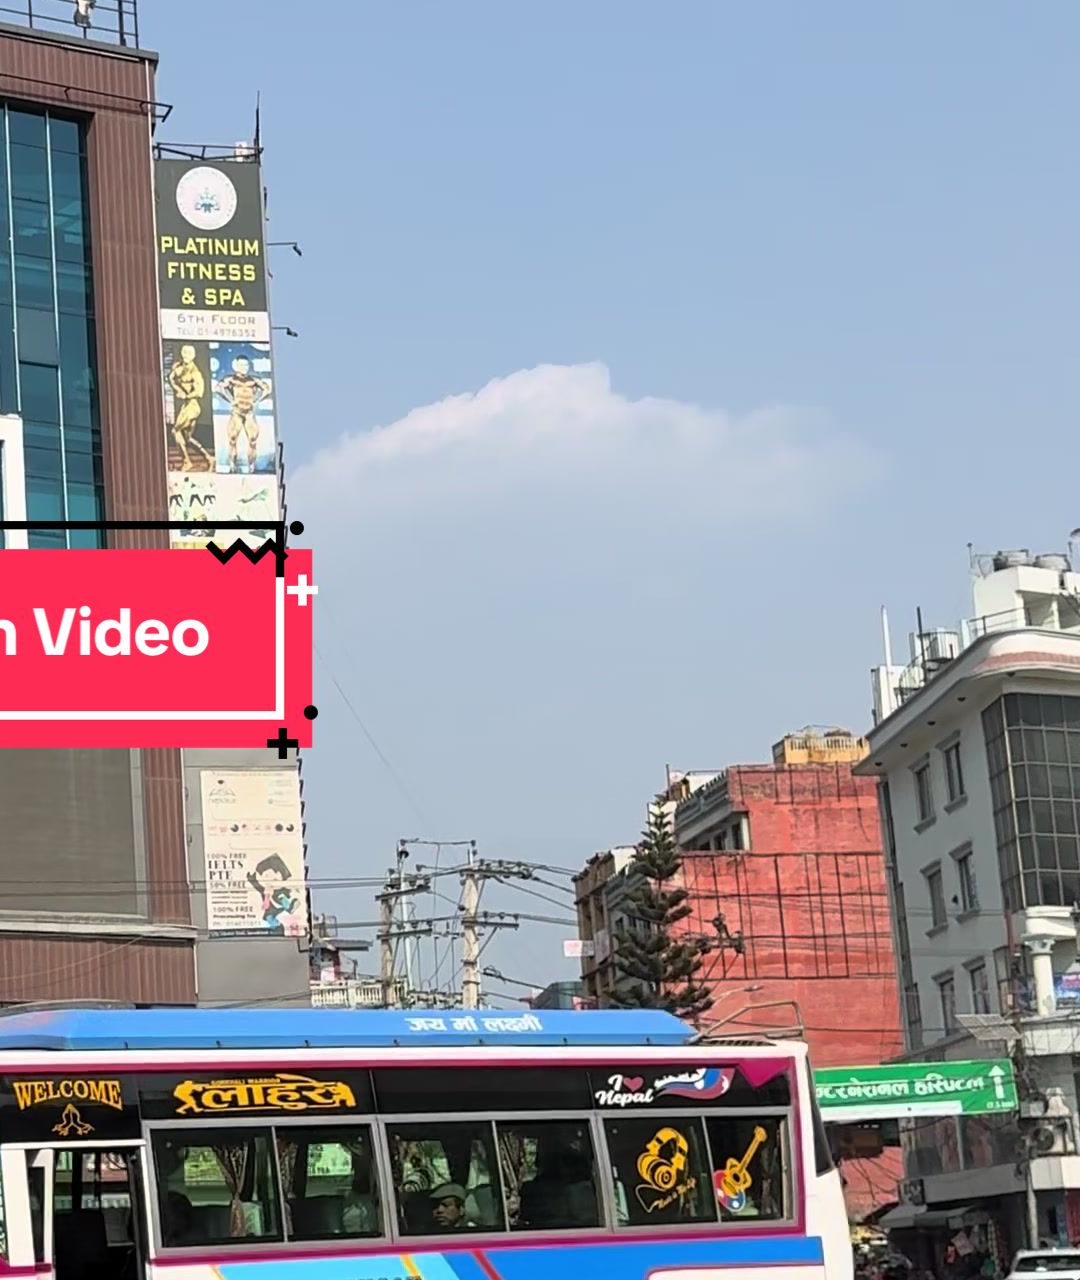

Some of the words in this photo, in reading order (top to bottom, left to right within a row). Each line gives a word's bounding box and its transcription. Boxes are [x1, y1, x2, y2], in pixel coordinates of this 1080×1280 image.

[161, 235, 260, 257] PLATINUM
[167, 261, 256, 282] FITNESS
[181, 287, 196, 305] &
[204, 287, 246, 307] SPA
[608, 1074, 623, 1091] I
[12, 1080, 122, 1111] WELCOME
[595, 1088, 654, 1107] Nepal
